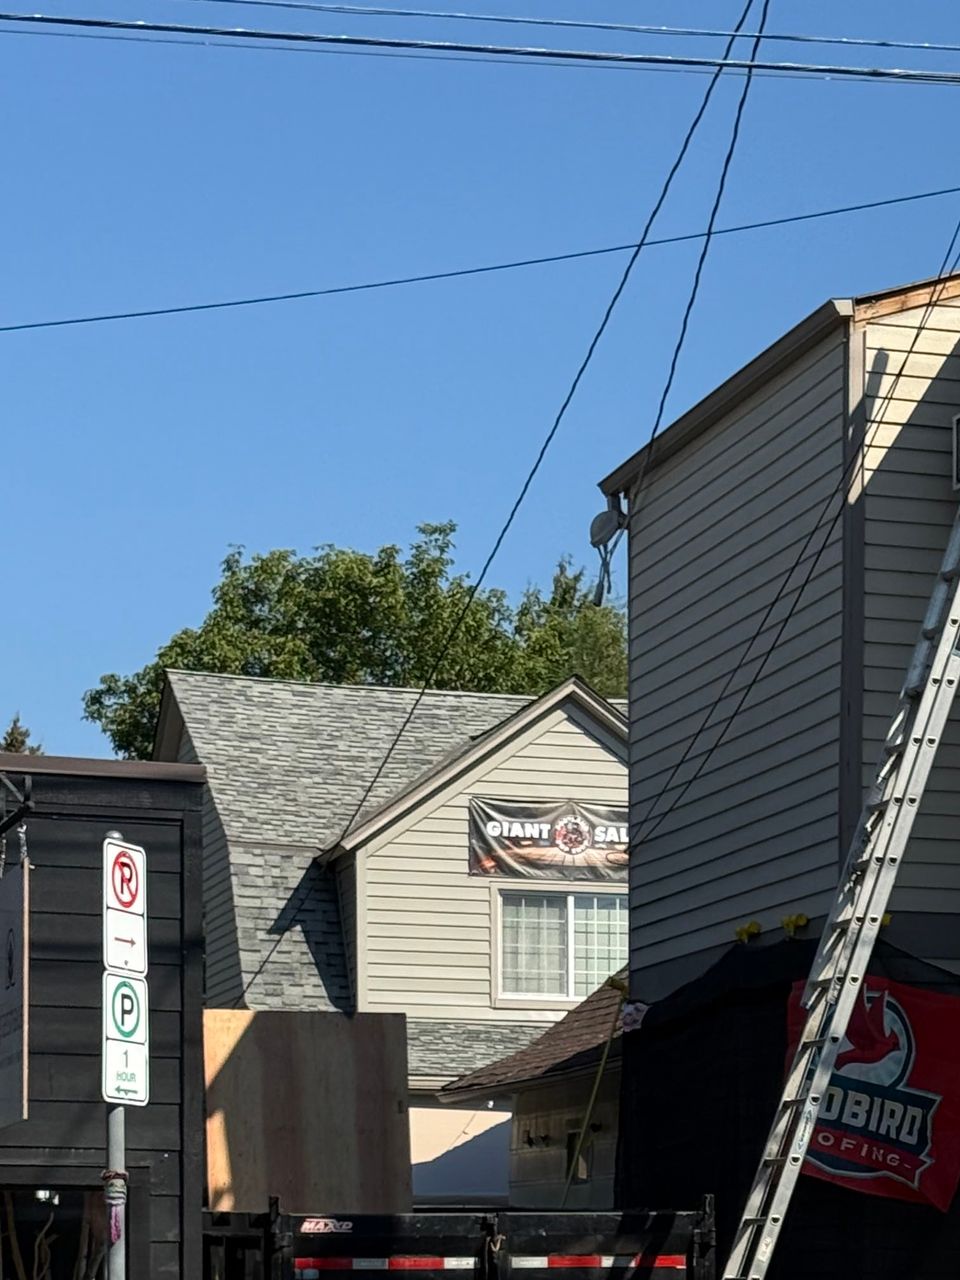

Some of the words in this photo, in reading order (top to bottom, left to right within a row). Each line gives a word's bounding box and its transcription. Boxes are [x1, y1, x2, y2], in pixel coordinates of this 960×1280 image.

[486, 821, 551, 839] GIANT
[594, 826, 629, 842] SAL
[121, 993, 134, 1027] P
[123, 1049, 128, 1069] 1
[116, 1071, 137, 1083] HOUR
[816, 1086, 924, 1146] DBIRD
[817, 1132, 901, 1166] OFING
